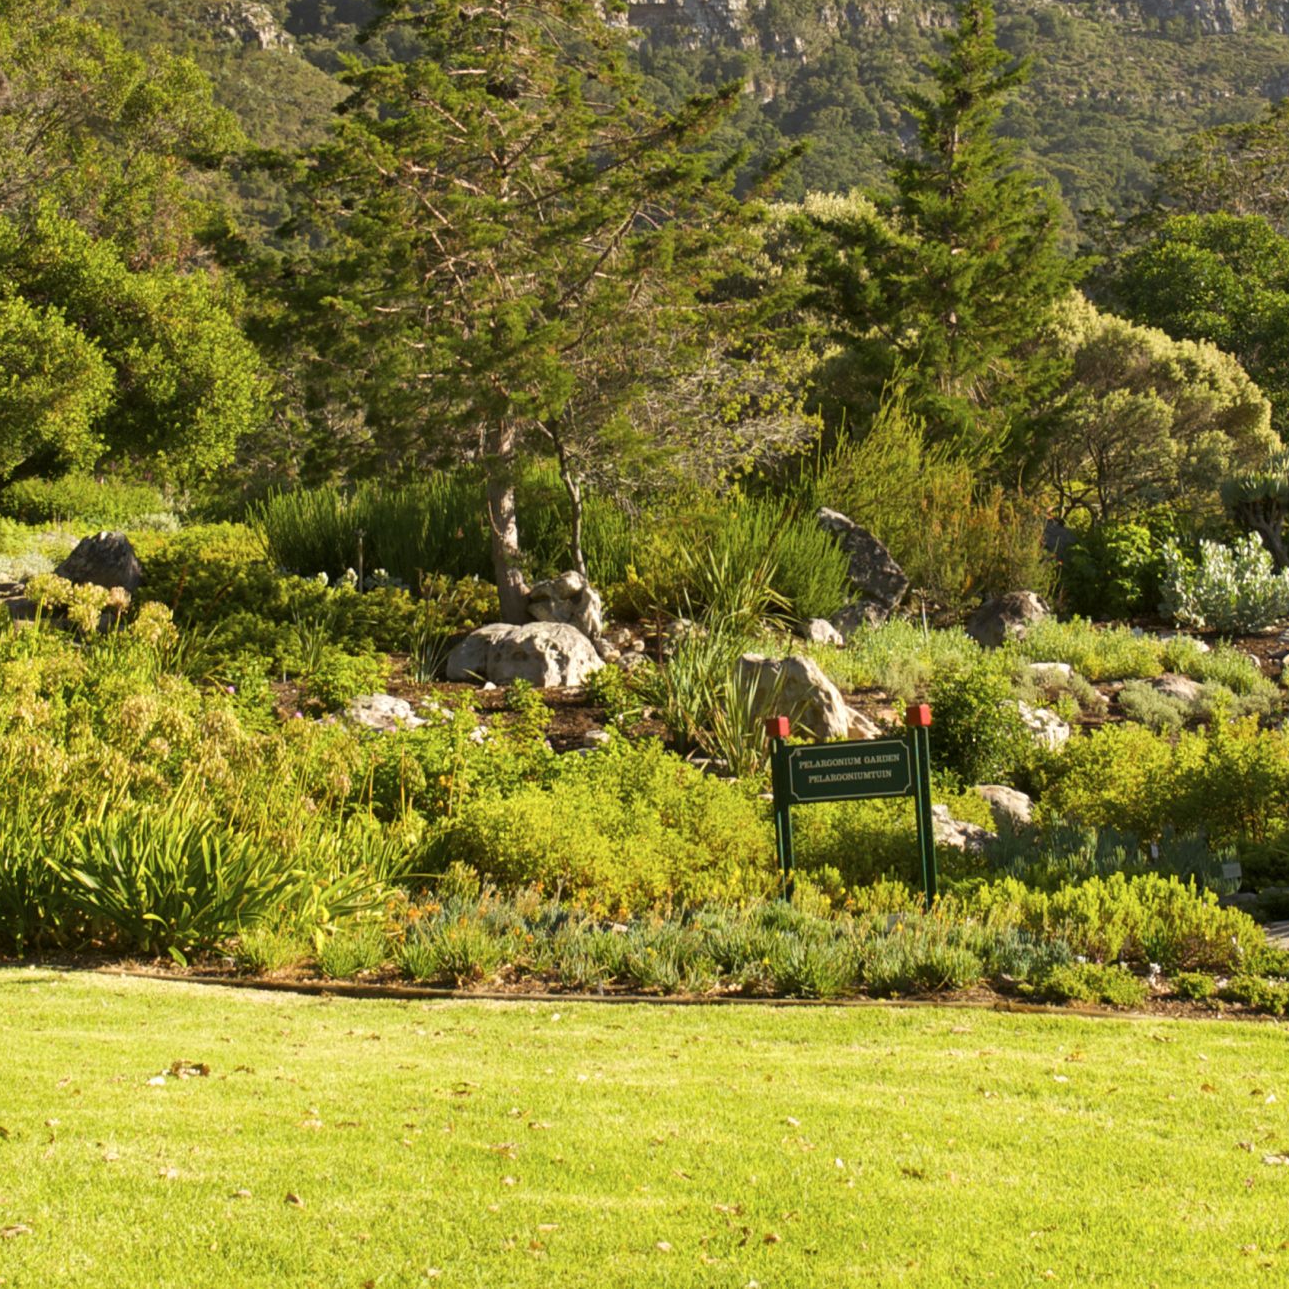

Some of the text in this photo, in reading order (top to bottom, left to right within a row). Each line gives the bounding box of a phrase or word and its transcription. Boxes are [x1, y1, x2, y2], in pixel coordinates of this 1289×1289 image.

[799, 753, 900, 769] PELARGONIUM GARDEN
[808, 770, 892, 783] PELARGONIUMTUIN
